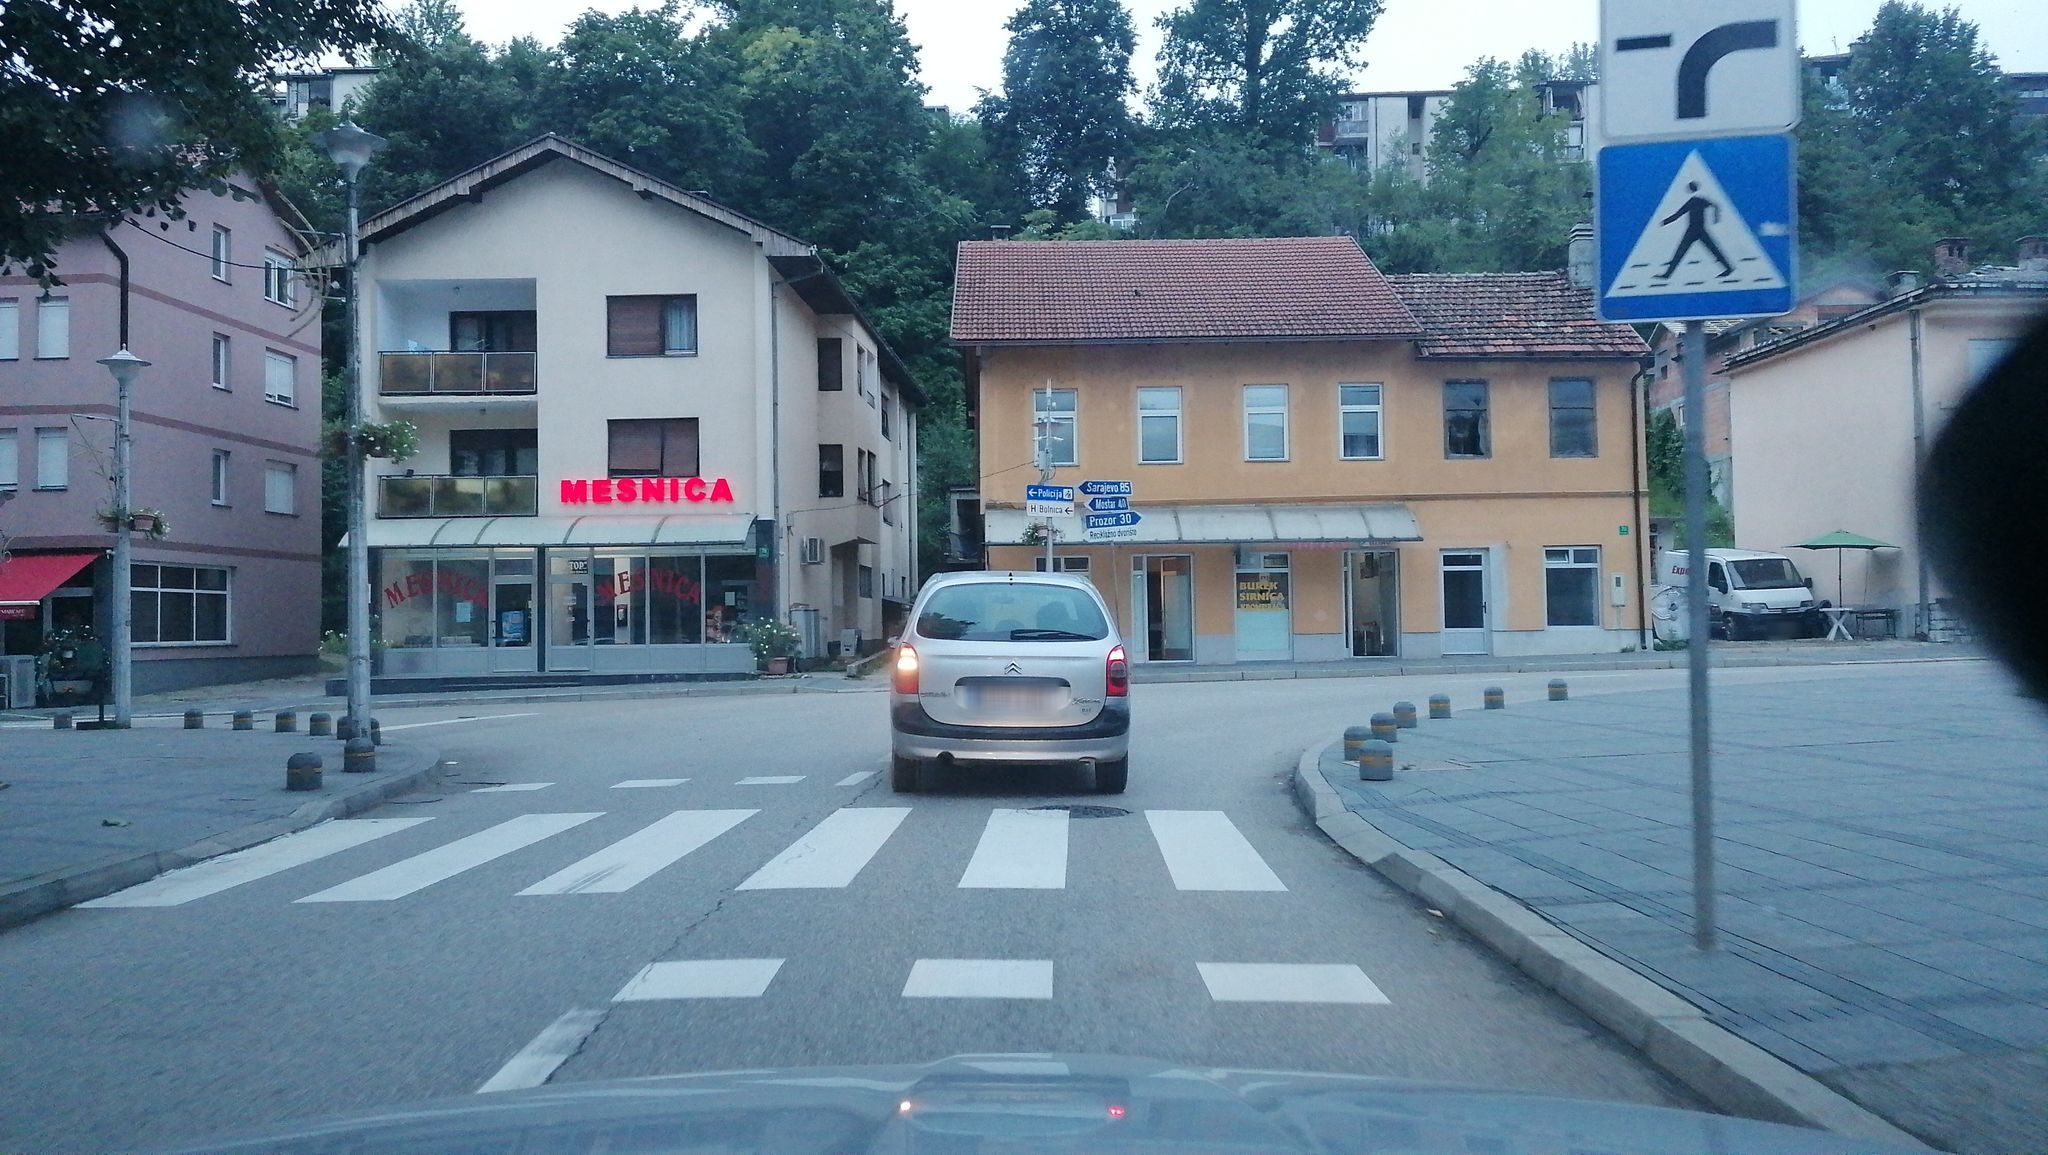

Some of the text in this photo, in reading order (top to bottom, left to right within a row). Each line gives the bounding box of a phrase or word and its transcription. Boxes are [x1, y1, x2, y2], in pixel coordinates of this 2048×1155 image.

[560, 477, 734, 504] MESNICA
[1037, 488, 1063, 500] Policija
[1086, 481, 1130, 495] Sarajevo 85
[1039, 504, 1063, 514] Bolnica
[1095, 499, 1116, 510] Mostar
[1089, 513, 1132, 527] Prozor 30
[596, 567, 701, 606] MESNICA
[1239, 581, 1279, 590] BUREK
[1239, 592, 1285, 601] SIRNICA
